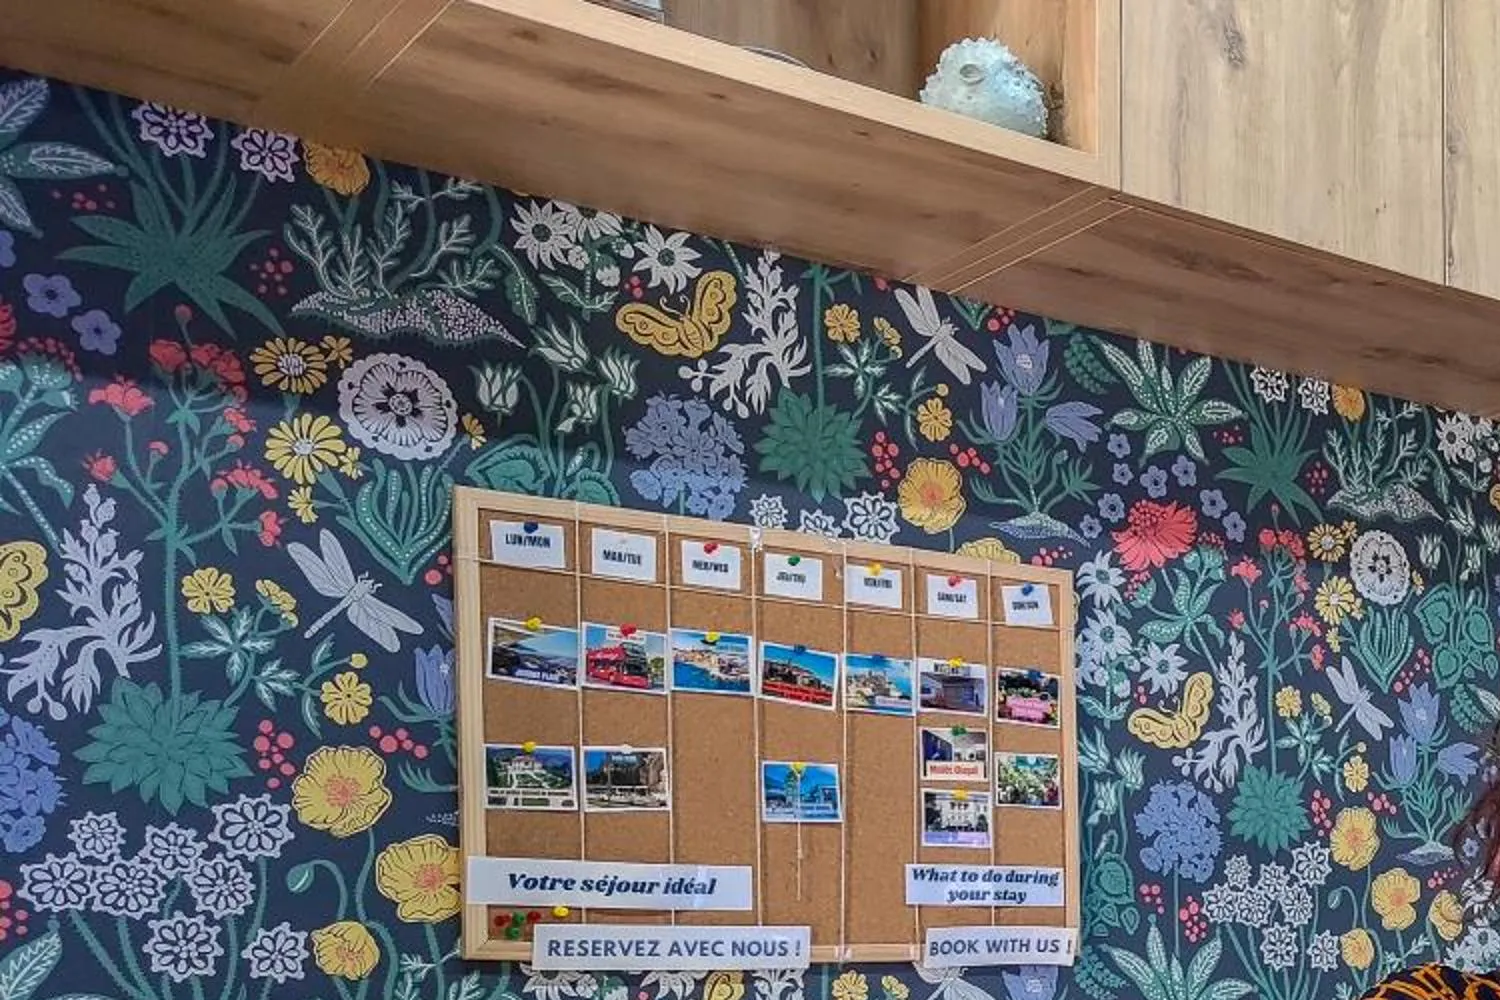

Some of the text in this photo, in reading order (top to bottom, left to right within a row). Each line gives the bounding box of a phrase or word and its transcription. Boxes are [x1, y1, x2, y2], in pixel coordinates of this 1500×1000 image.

[508, 873, 717, 897] Votre séjour idéal
[912, 868, 1060, 887] What to do during
[947, 889, 1027, 904] your stay
[547, 938, 660, 957] RESERVEZ
[667, 938, 724, 957] AVEC
[731, 939, 789, 957] NOUS
[929, 938, 980, 957] BOOK
[985, 938, 1030, 954] WITH
[1035, 938, 1061, 953] US
